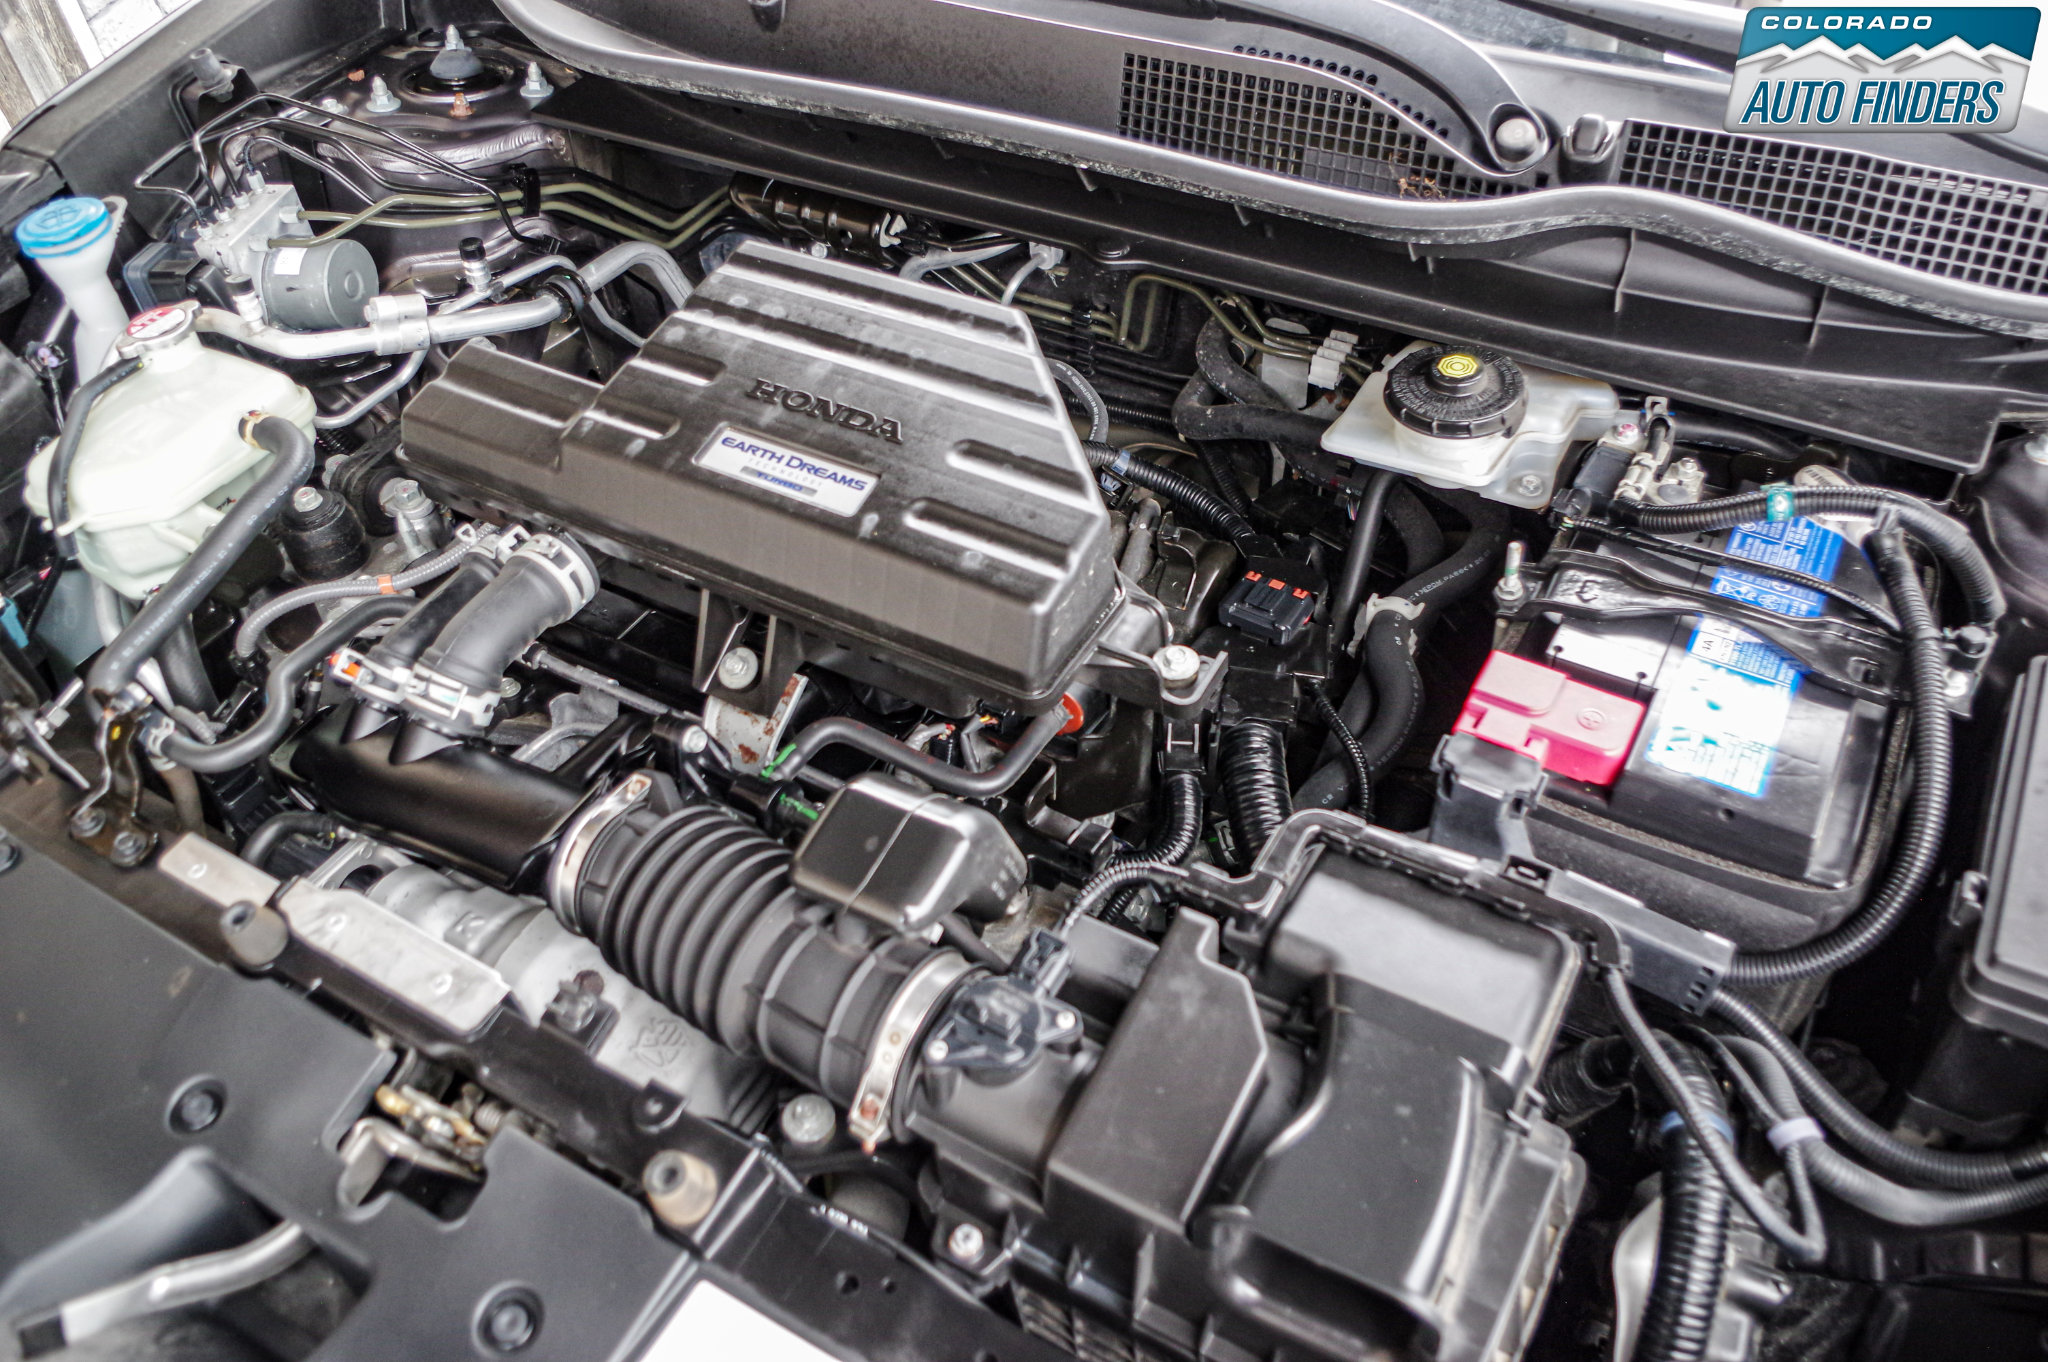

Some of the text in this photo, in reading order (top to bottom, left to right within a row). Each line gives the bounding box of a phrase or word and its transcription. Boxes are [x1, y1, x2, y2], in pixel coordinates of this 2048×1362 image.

[745, 377, 904, 445] HONDA
[721, 437, 868, 491] EARTH DREAMS
[756, 471, 804, 492] TURBO
